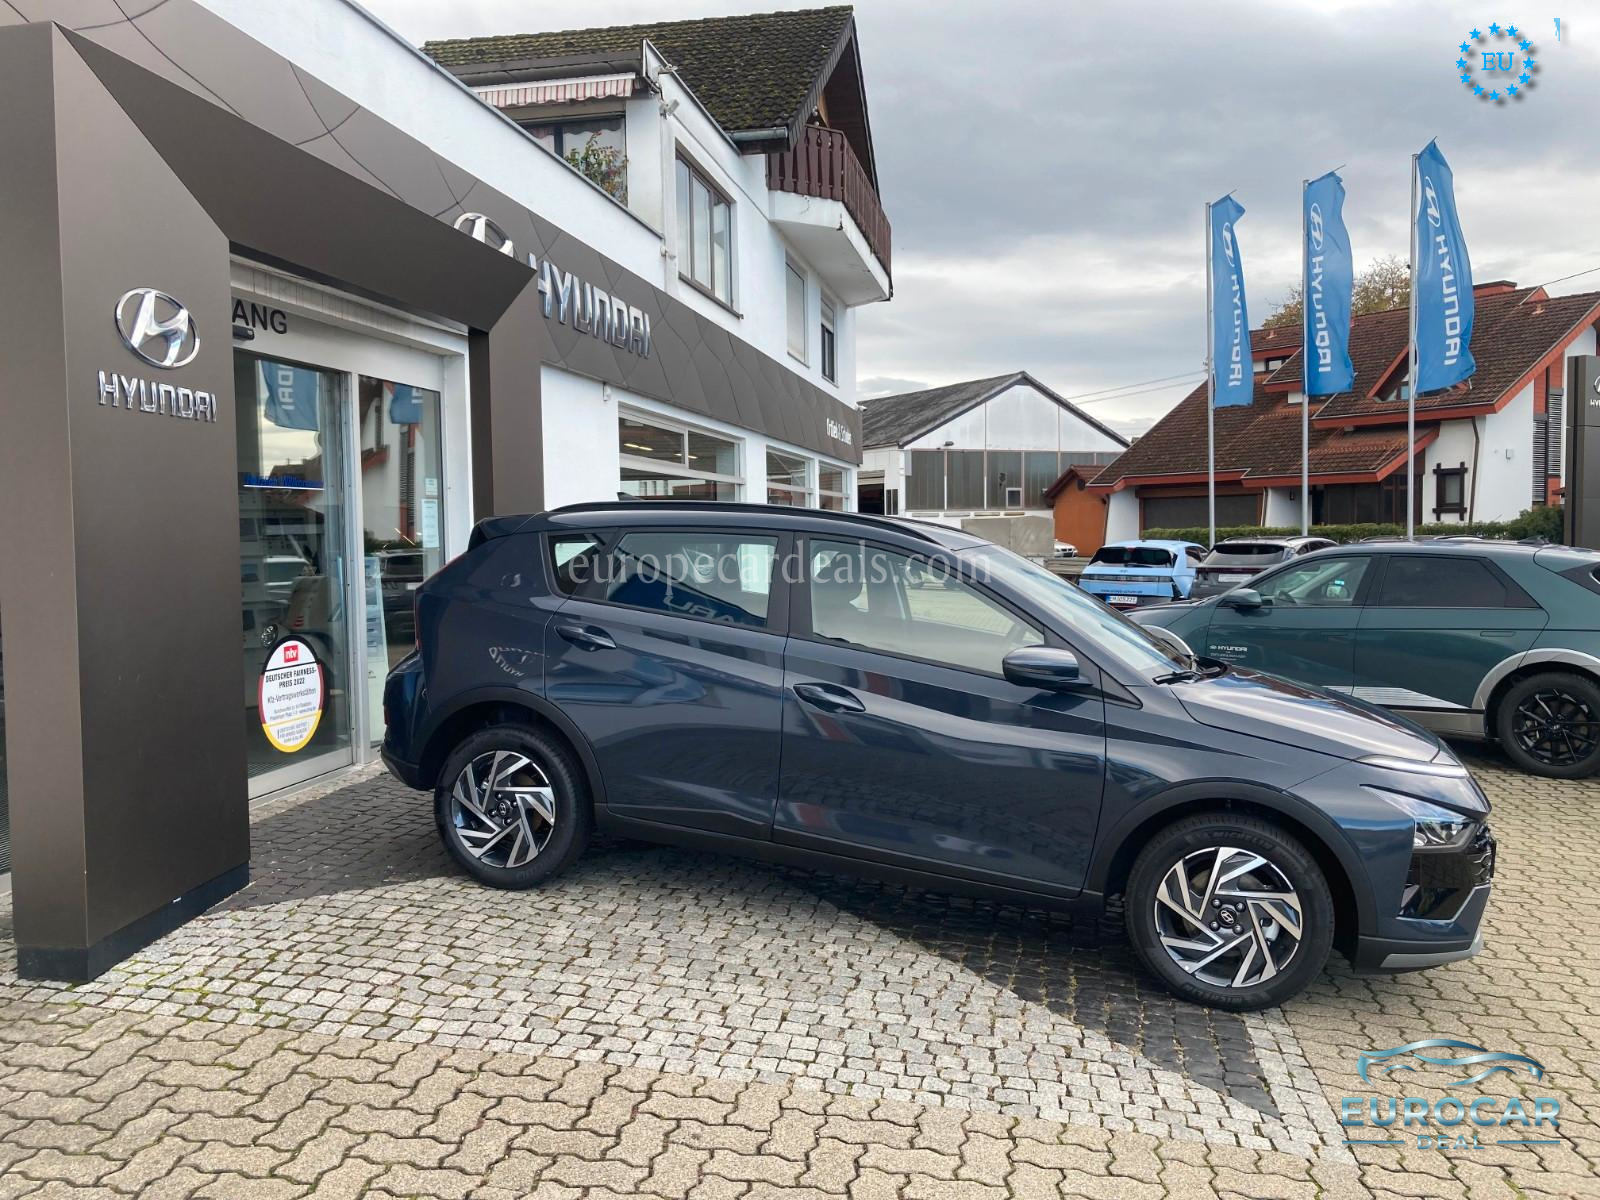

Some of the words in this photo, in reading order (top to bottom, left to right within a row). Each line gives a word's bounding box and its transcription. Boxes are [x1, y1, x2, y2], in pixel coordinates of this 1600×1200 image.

[232, 298, 287, 334] ANG
[527, 252, 650, 358] HYUNDAI
[1311, 255, 1331, 373] HYUNDAI
[1435, 235, 1461, 366] HYUNDAI
[1228, 274, 1242, 386] HYUNDAI
[98, 370, 217, 422] HYUNDAI
[265, 671, 293, 683] DEUTSCHER
[285, 648, 297, 660] ntv
[279, 680, 293, 688] PREIS
